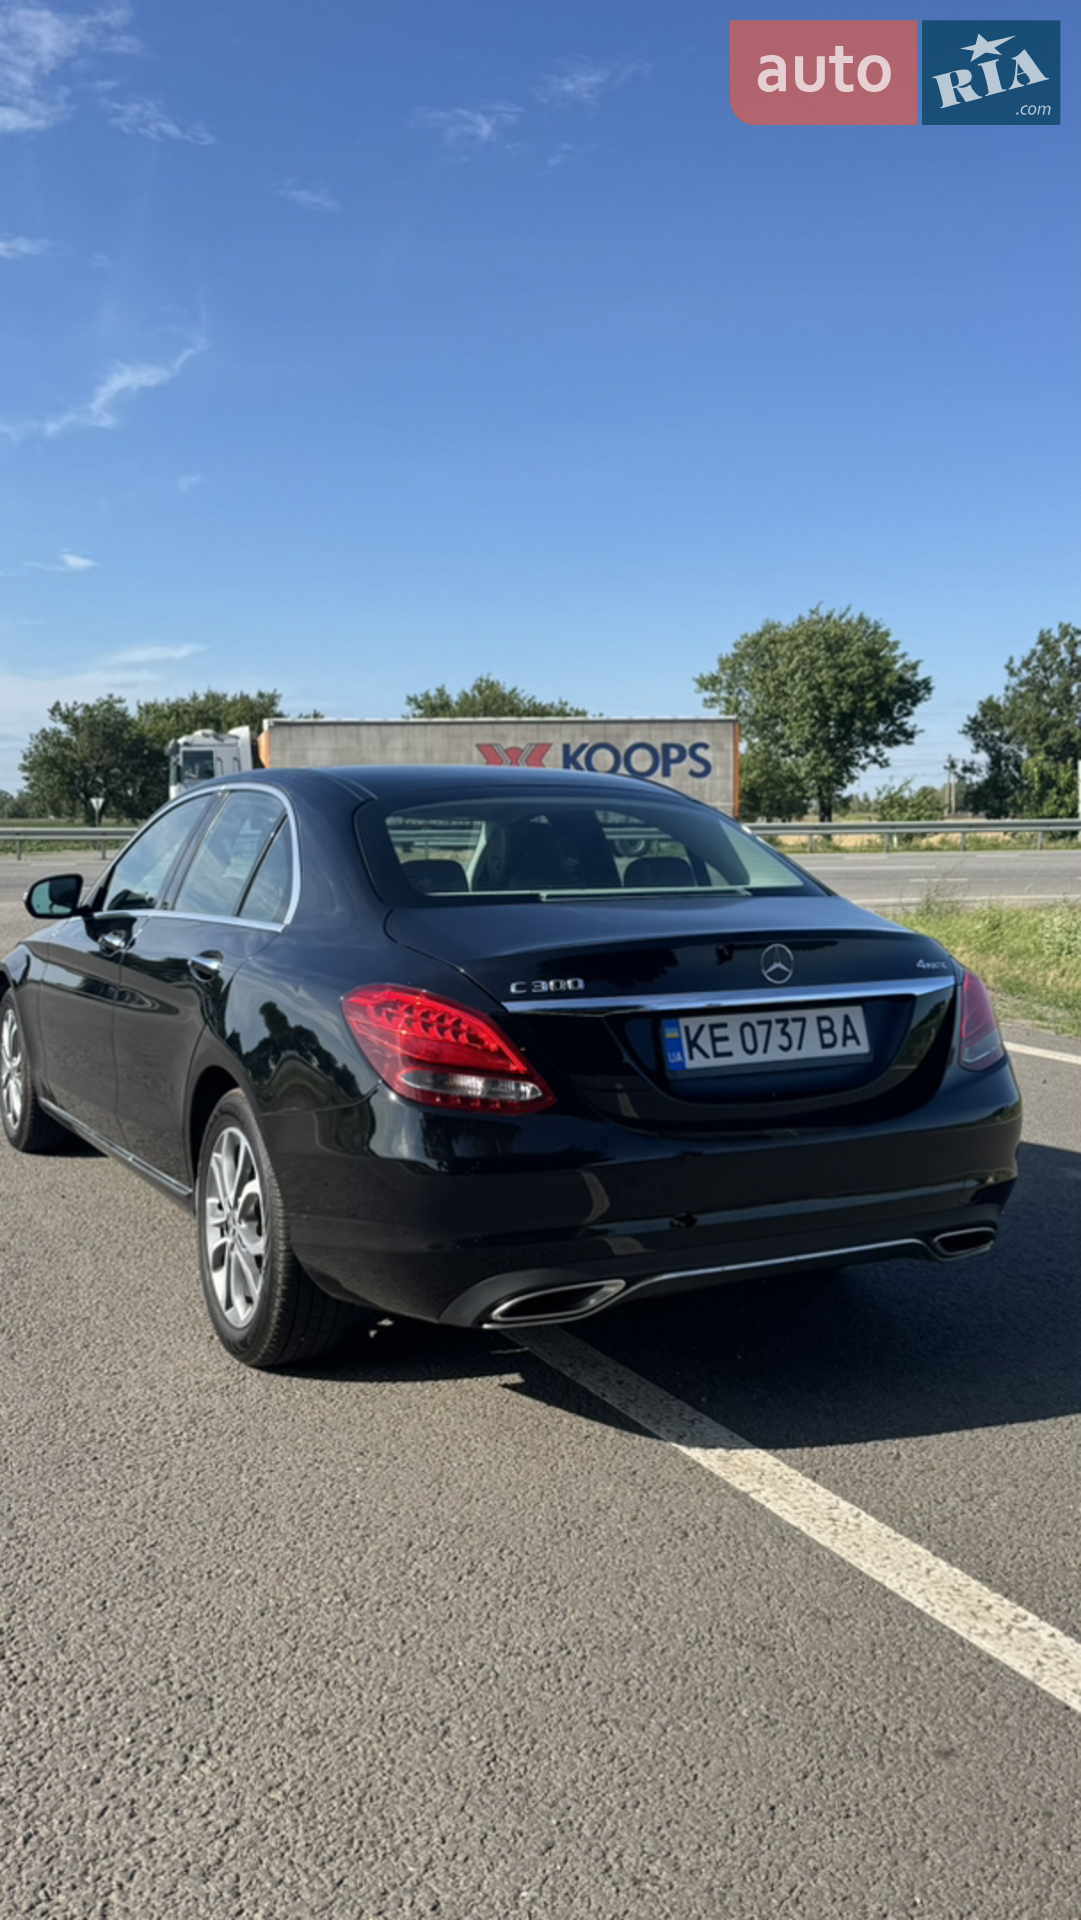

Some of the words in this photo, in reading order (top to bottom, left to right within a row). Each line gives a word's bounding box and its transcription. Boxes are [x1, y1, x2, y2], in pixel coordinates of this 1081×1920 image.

[562, 742, 712, 779] KOOPS
[684, 1022, 733, 1061] KE
[739, 1017, 807, 1056] 0737
[816, 1014, 861, 1050] BA
[667, 1051, 684, 1064] UA
